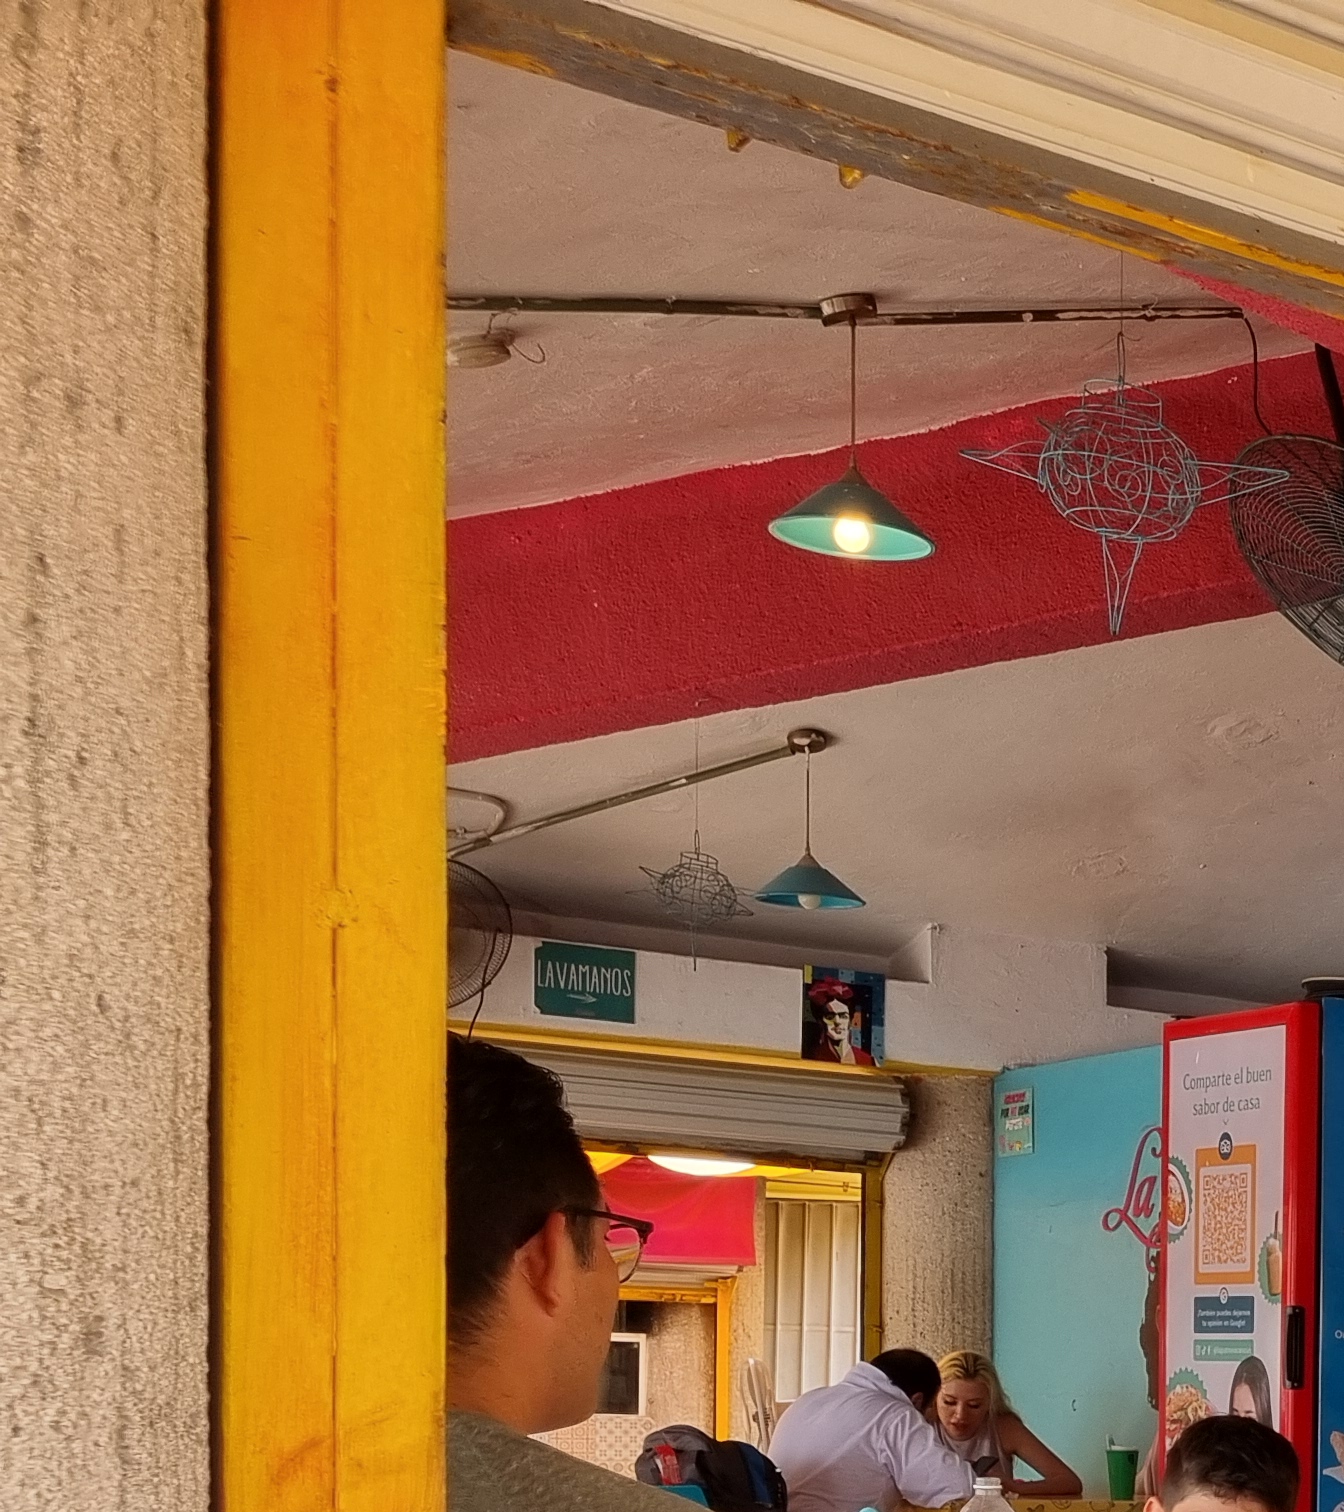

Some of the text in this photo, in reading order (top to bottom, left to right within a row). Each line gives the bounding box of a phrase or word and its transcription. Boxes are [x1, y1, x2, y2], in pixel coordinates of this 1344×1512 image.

[537, 959, 631, 997] LAVAMANOS
[1183, 1066, 1272, 1093] Comparte el buen
[1192, 1096, 1260, 1116] sabor de casa
[1102, 1126, 1163, 1249] La
